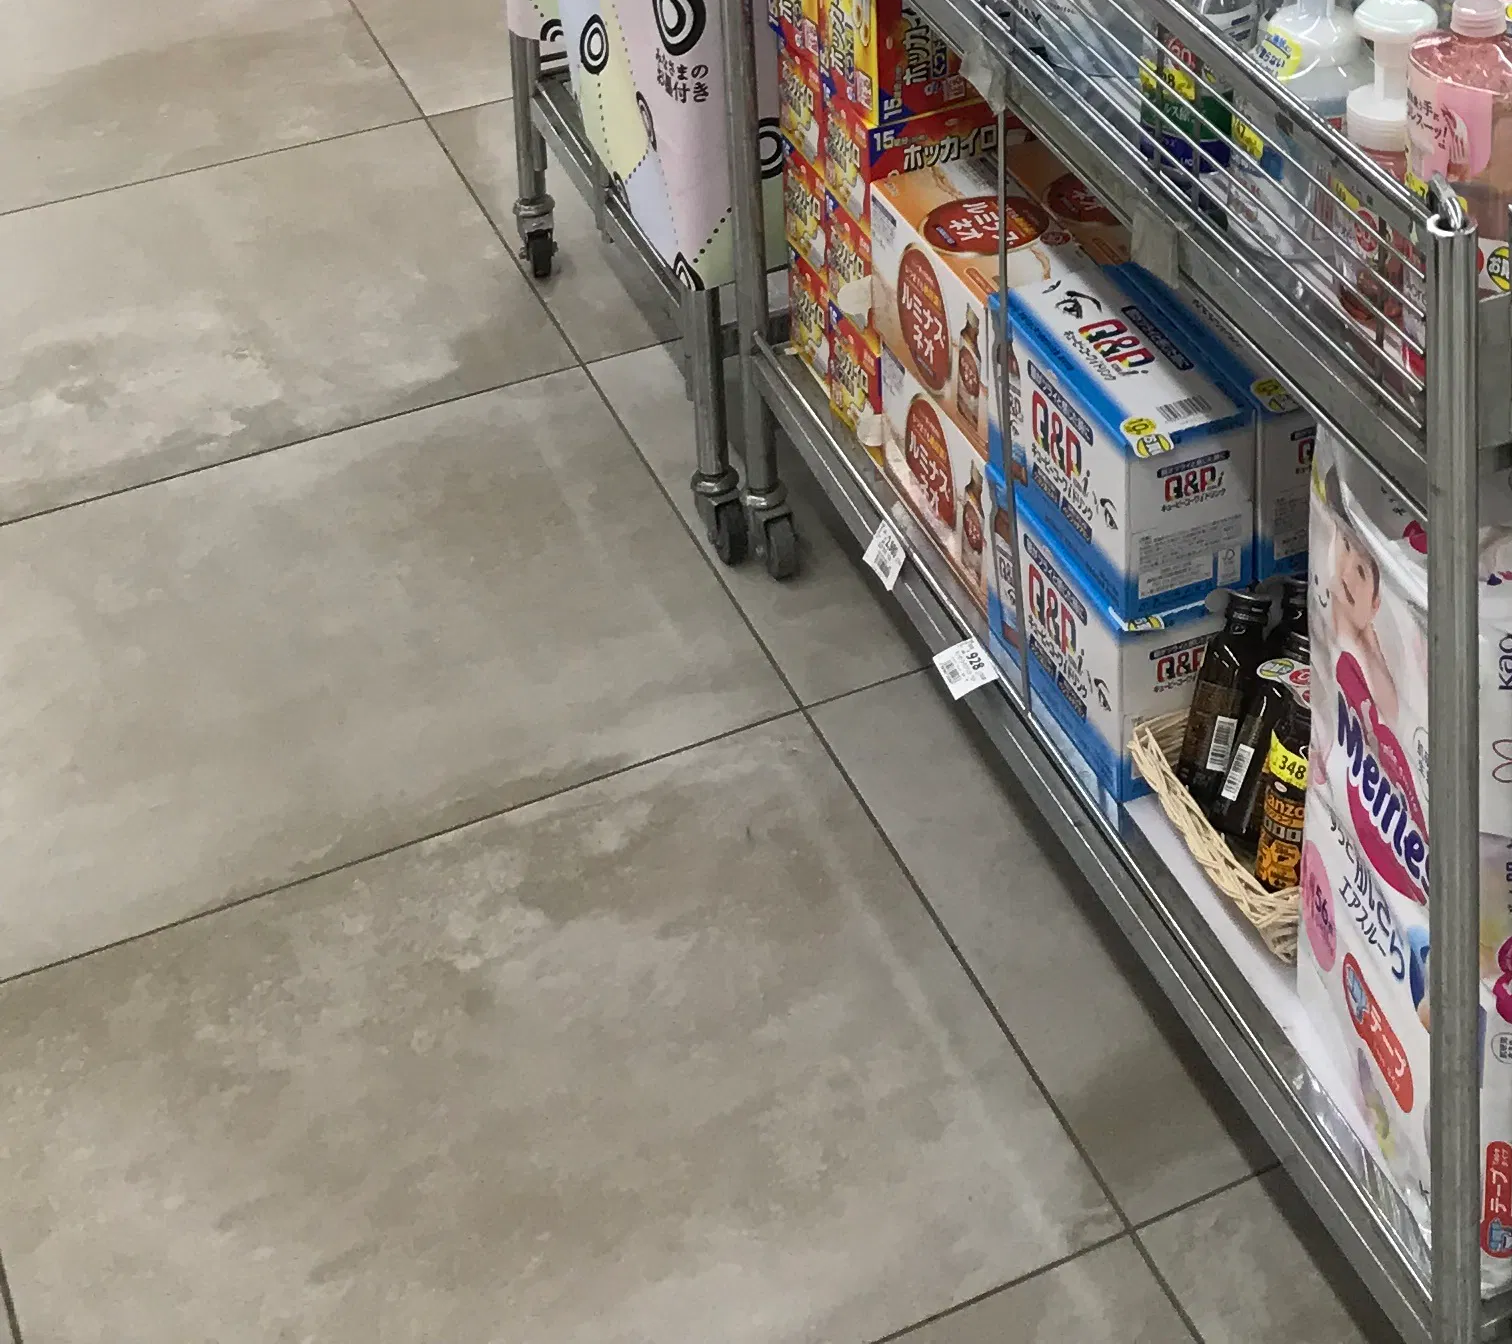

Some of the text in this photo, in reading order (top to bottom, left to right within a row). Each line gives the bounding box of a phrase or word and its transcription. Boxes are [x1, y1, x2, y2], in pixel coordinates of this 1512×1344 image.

[904, 124, 998, 171] ホッカイロ
[1279, 755, 1307, 781] 348
